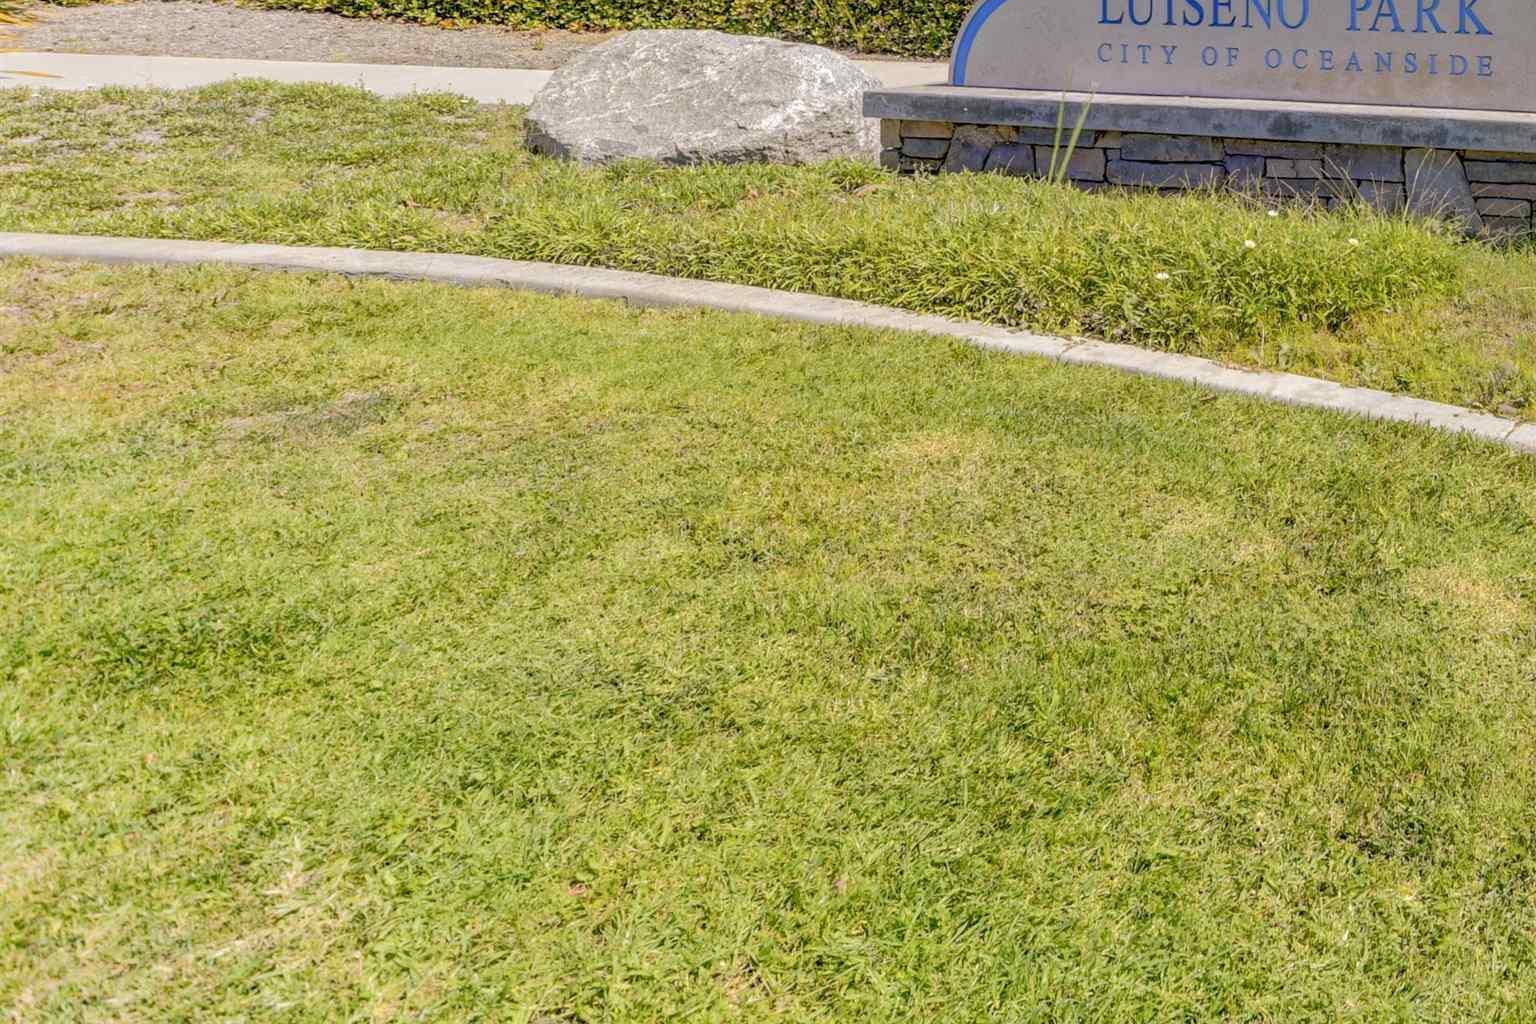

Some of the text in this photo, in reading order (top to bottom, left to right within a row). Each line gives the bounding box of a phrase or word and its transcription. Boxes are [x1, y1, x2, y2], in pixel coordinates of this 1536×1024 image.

[1097, 43, 1494, 77] CITY OF OCEANSIDE
